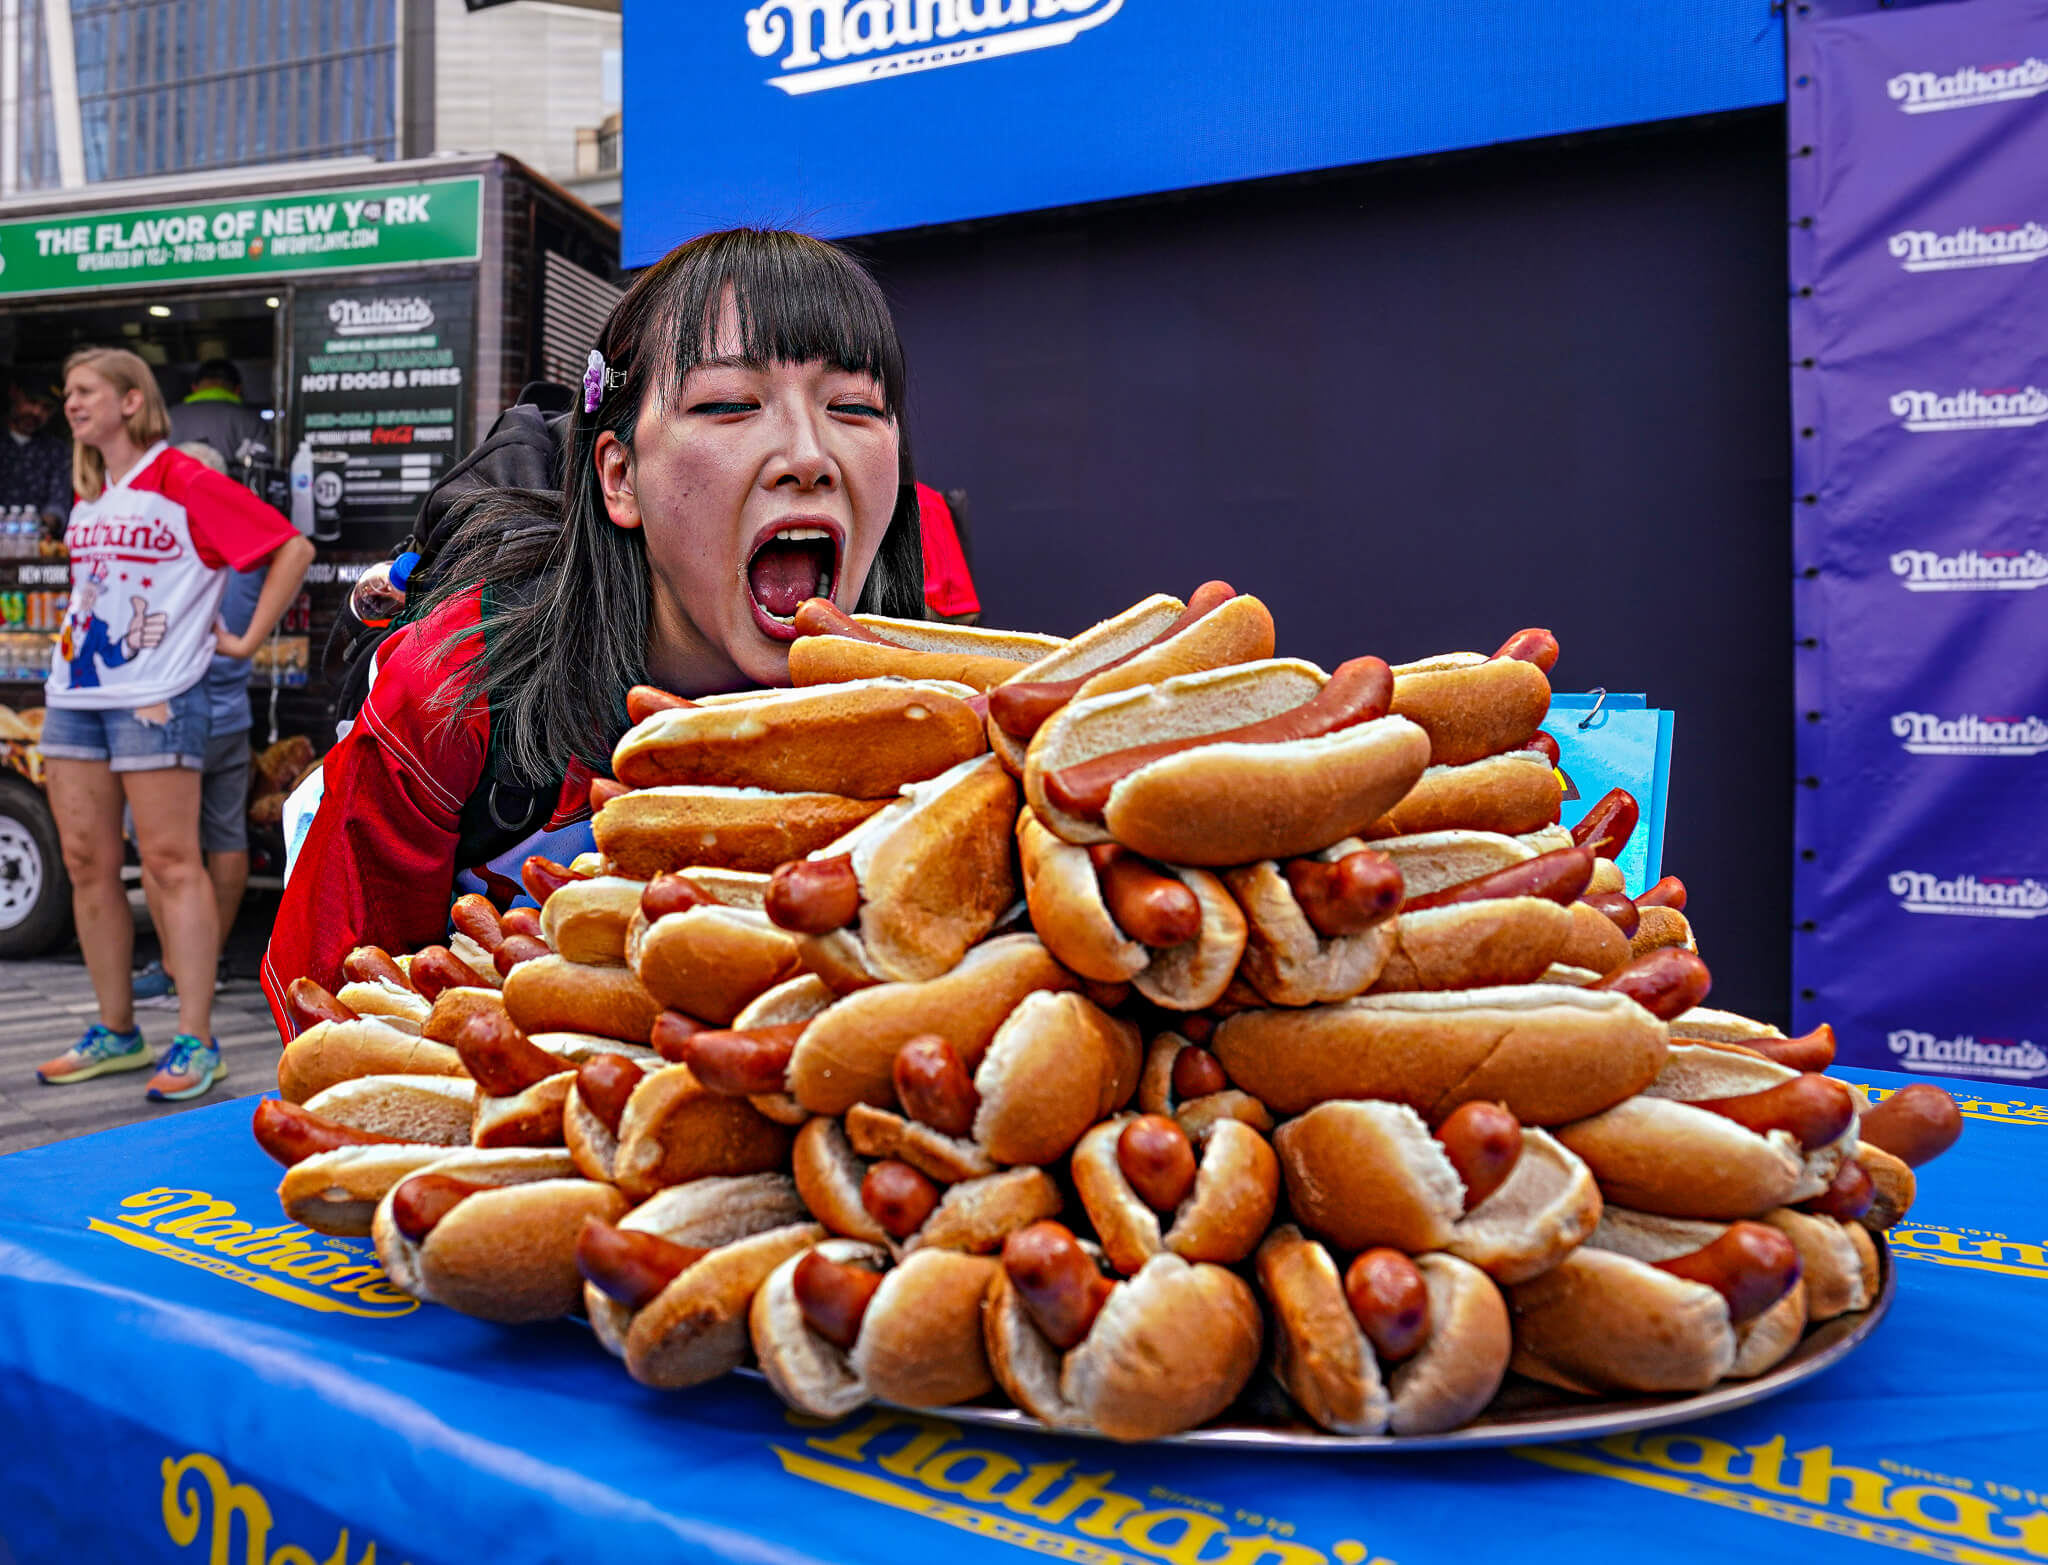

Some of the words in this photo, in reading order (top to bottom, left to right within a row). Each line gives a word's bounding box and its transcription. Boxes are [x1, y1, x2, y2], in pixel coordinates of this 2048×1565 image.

[35, 226, 91, 256] THE
[95, 215, 208, 250] FLAVOR
[212, 210, 256, 240] OF
[262, 202, 337, 237] NEW
[328, 297, 434, 326] Nathan's
[308, 352, 375, 373] WORLD
[377, 349, 454, 370] FAMOUS
[301, 374, 339, 392] HOT
[340, 371, 391, 391] DOGS
[392, 370, 407, 388] &
[409, 367, 462, 387] FRIES
[18, 565, 41, 584] NEW
[42, 565, 69, 584] YORK
[1888, 870, 2048, 908] Nathan's
[1887, 1029, 2048, 1069] Nathan's
[1235, 1509, 1297, 1537] 1916
